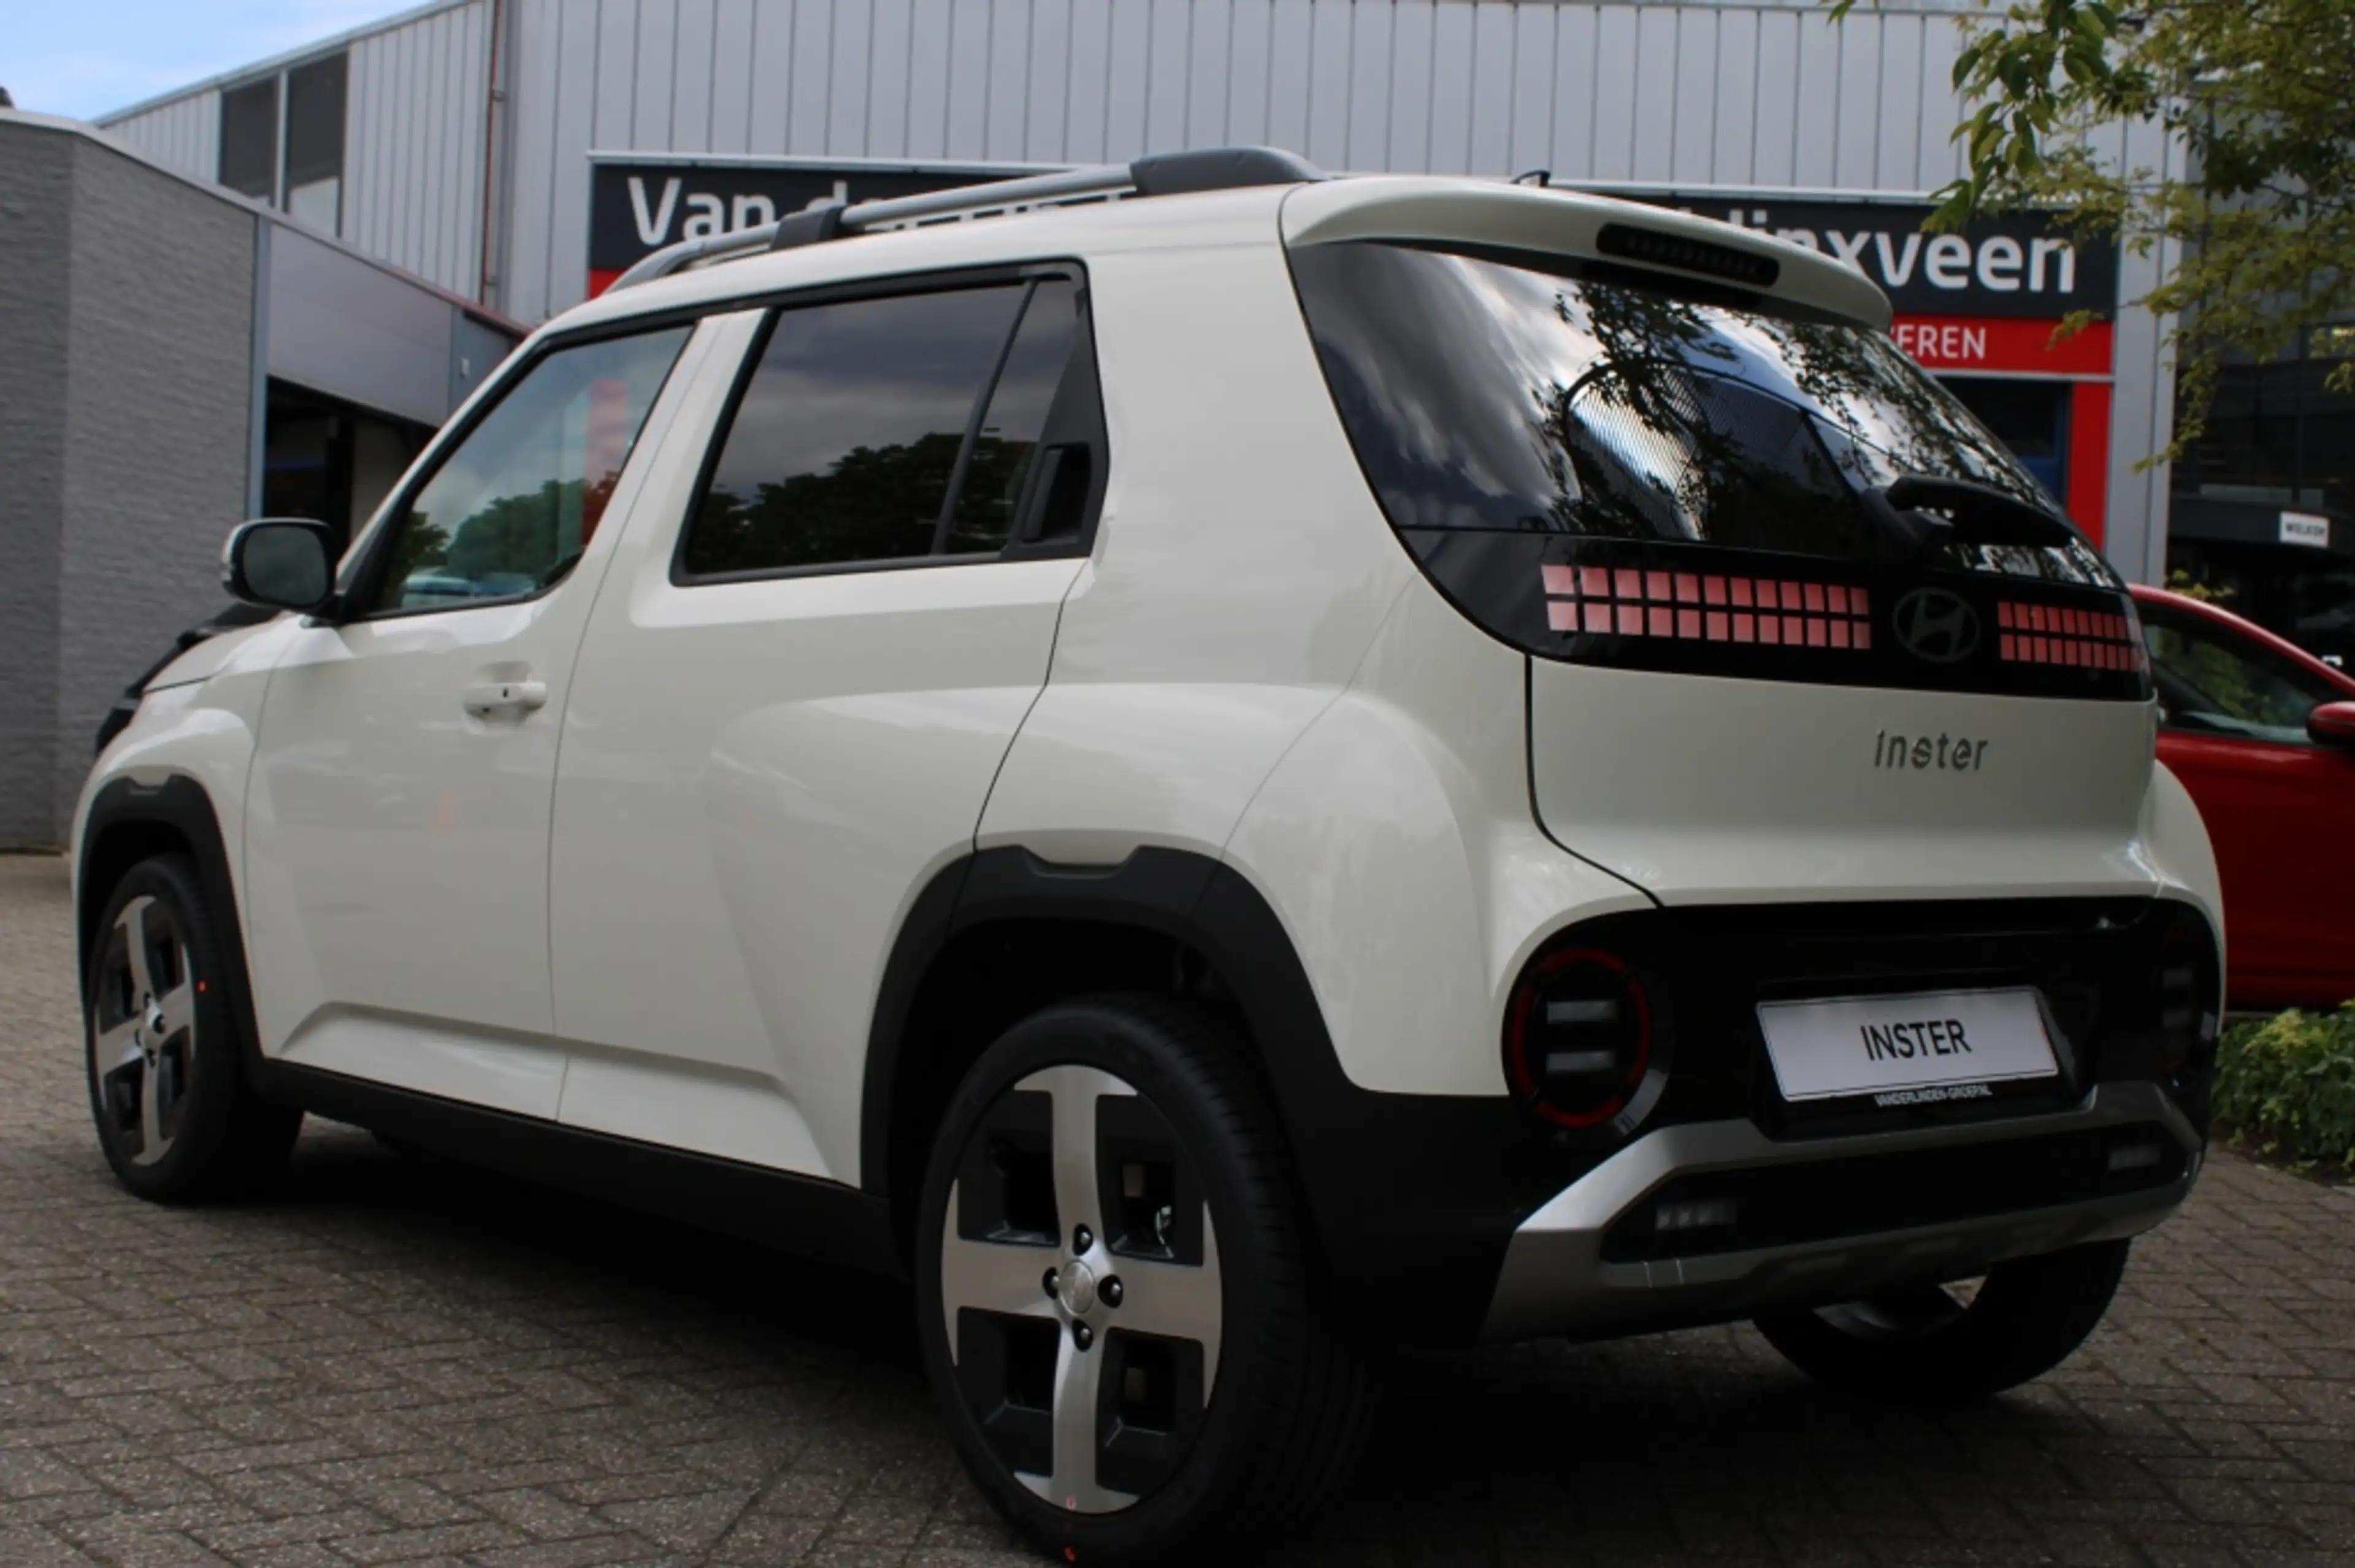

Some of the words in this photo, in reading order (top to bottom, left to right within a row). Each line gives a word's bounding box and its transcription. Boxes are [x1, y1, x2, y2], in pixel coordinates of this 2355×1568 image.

[627, 177, 776, 246] Van
[1891, 323, 1986, 361] EREN
[1861, 1019, 1972, 1061] INSTER
